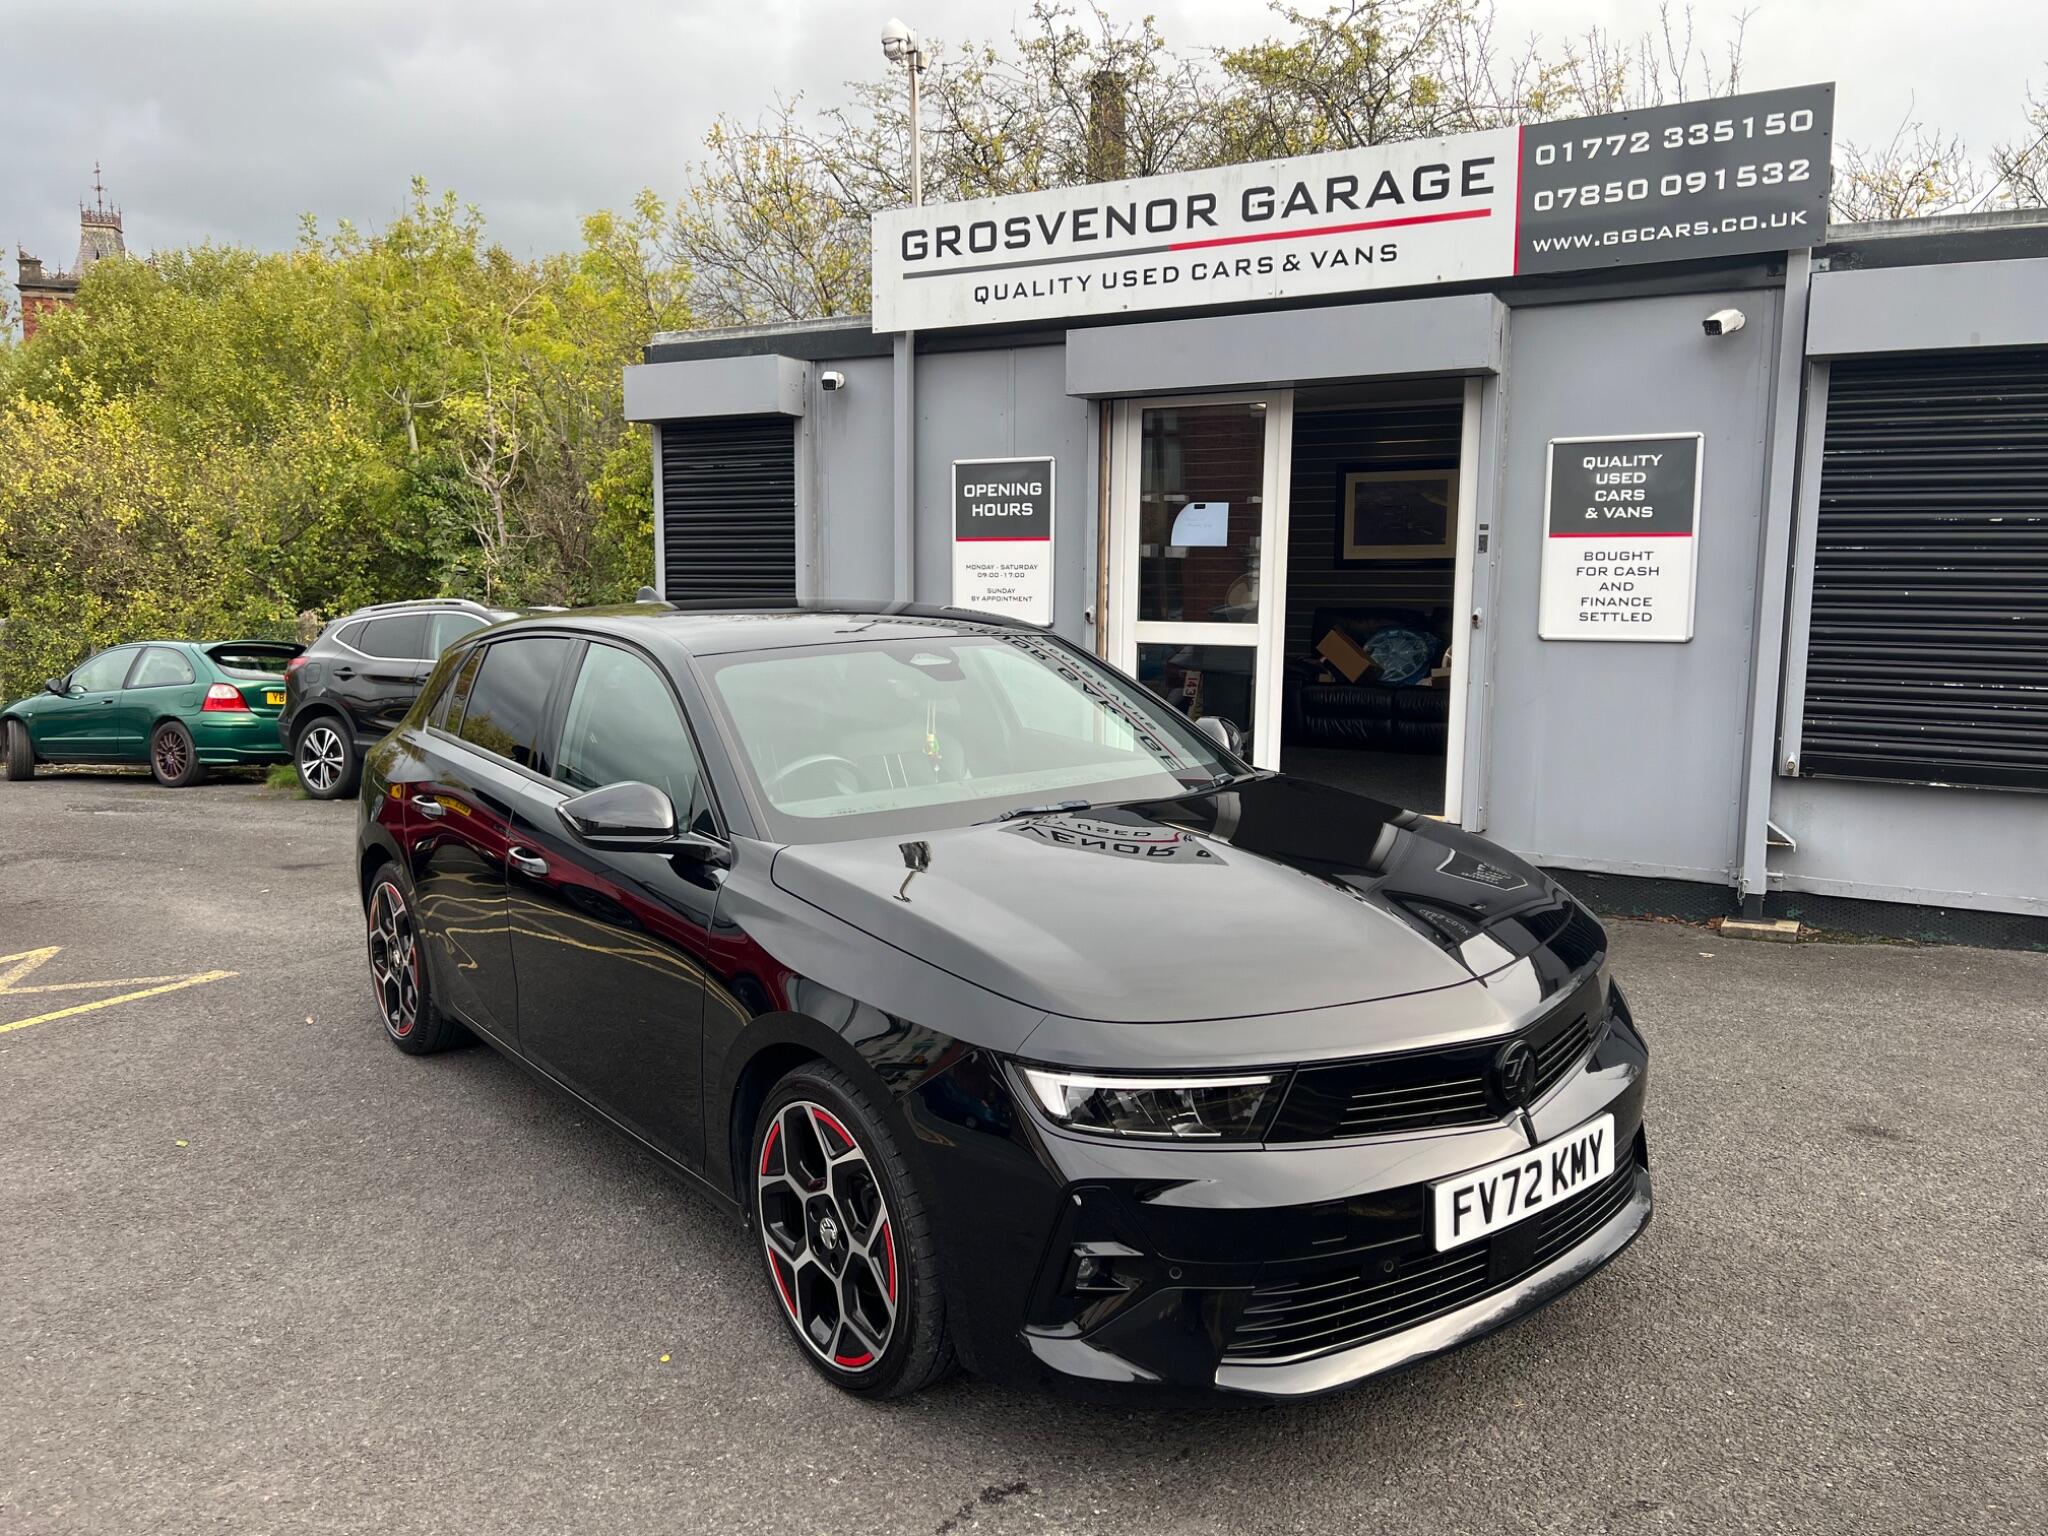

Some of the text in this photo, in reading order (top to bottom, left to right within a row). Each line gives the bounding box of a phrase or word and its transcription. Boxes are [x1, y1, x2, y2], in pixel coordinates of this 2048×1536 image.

[1535, 108, 1814, 166] 01772 335150
[1533, 158, 1811, 212] 07850 091532
[900, 156, 1496, 262] GROSVENOR GARAGE
[1532, 210, 1808, 253] WWW.GGCARS.CO.UK
[973, 243, 1399, 304] QUALITY USED CARS & VANS
[1583, 454, 1664, 470] QUALITY
[1595, 472, 1647, 485] USED
[963, 482, 1042, 497] OPENING
[1594, 489, 1646, 502] CARS
[972, 502, 1034, 517] HOURS
[1585, 506, 1654, 519] & VANS
[1583, 551, 1655, 562] BOUGHT
[1576, 565, 1660, 577] FOR CASH
[1598, 581, 1635, 592] AND
[1580, 596, 1653, 607] FINANCE
[1579, 611, 1653, 623] SETTLED
[1452, 1128, 1604, 1238] FV72 KMY
